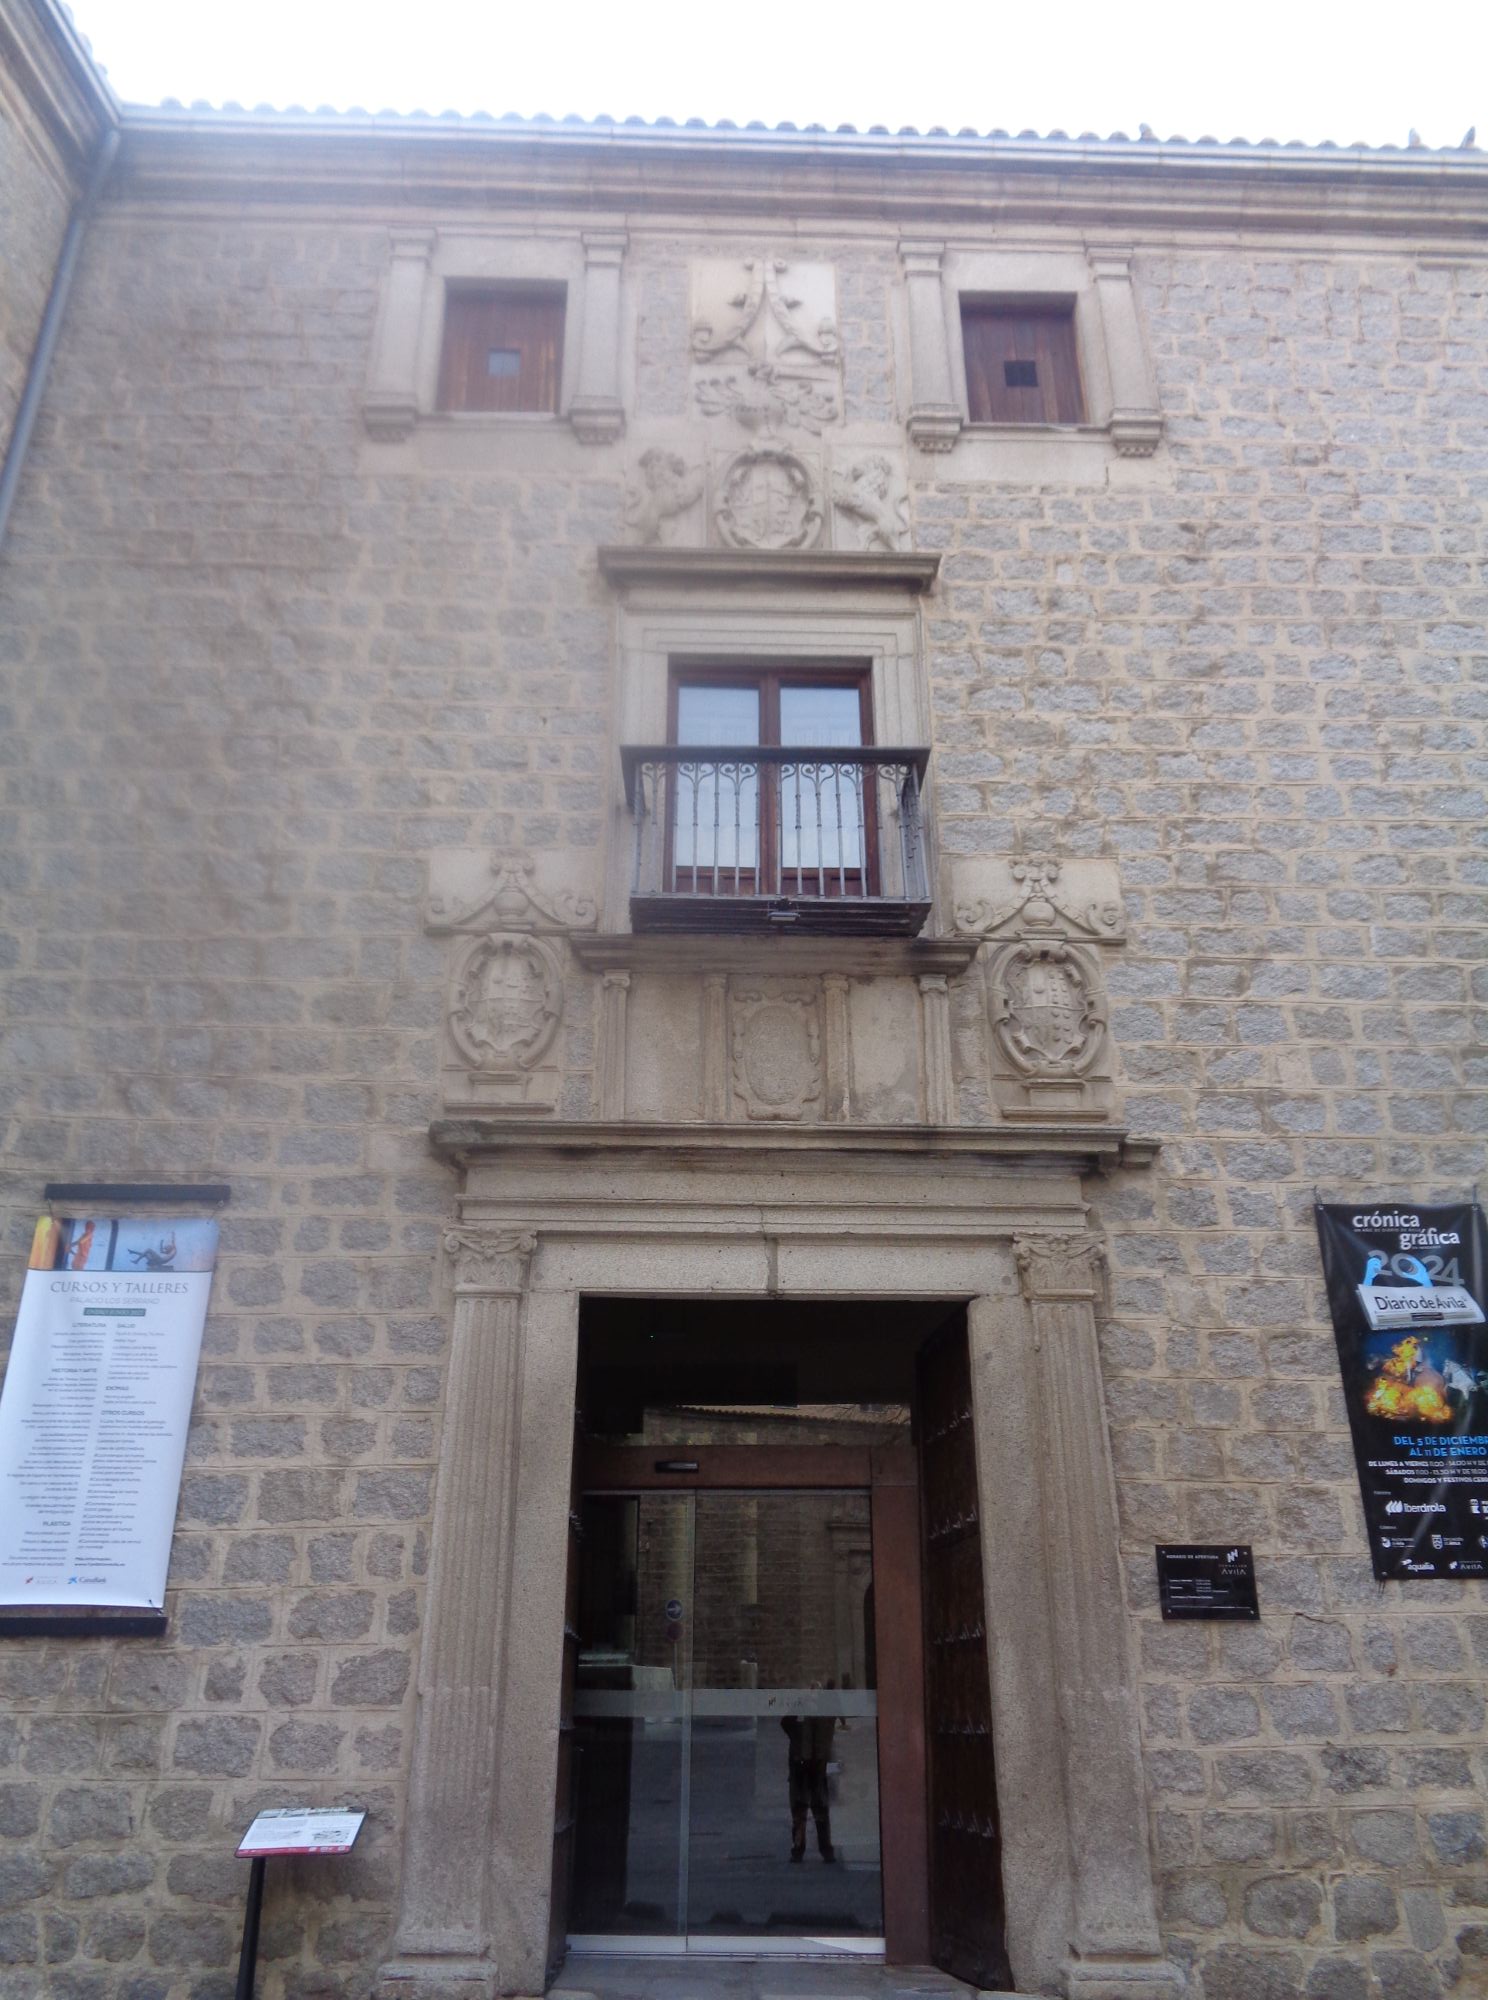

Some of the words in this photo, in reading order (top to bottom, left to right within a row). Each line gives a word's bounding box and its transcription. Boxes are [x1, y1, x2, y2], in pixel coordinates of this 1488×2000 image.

[1352, 1210, 1420, 1228] crónica
[1399, 1227, 1461, 1250] gráfica
[1367, 1249, 1465, 1287] 2024
[50, 1281, 108, 1294] CURSOS
[112, 1282, 122, 1294] Y
[125, 1282, 189, 1294] TALLERES
[1374, 1295, 1419, 1311] Diario
[1420, 1296, 1435, 1310] de
[1436, 1295, 1467, 1309] Ávila
[1393, 1436, 1416, 1446] DEL
[1417, 1438, 1424, 1446] 5
[1424, 1436, 1438, 1446] DE
[1409, 1447, 1424, 1457] AL
[1433, 1447, 1449, 1457] DE
[1449, 1446, 1488, 1456] ENERO
